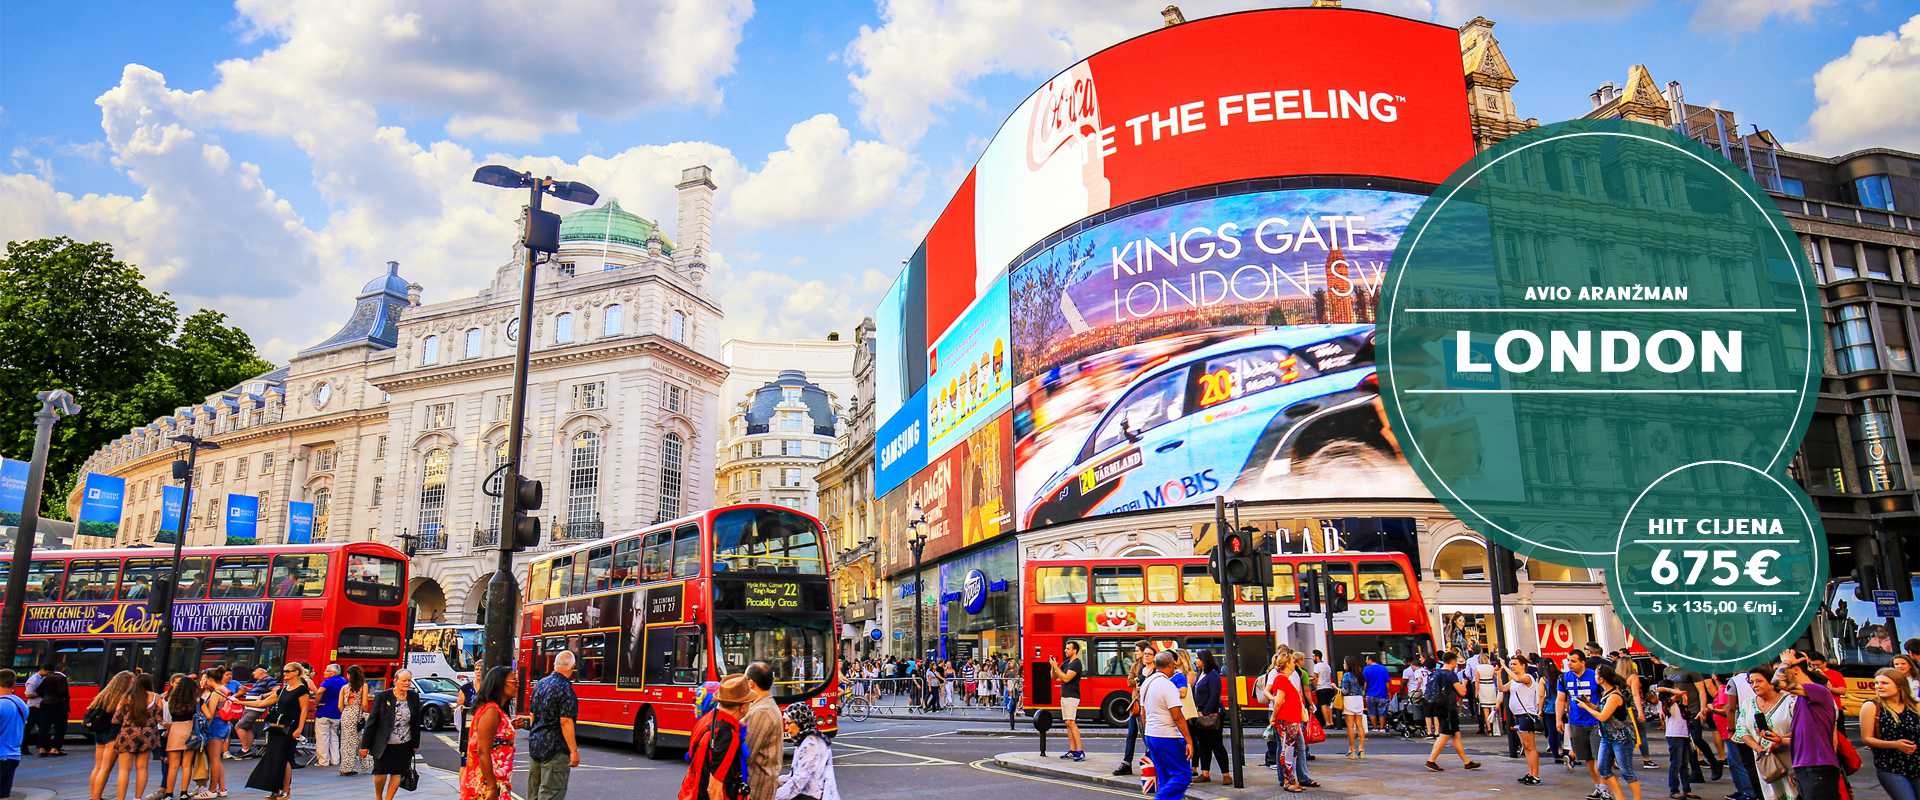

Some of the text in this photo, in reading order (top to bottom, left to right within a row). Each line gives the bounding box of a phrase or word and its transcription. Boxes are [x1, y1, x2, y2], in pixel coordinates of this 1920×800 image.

[1125, 101, 1207, 147] THE
[1112, 215, 1368, 281] KINGS GATE
[1114, 261, 1311, 323] LONDON
[1200, 370, 1231, 406] 20
[881, 419, 920, 472] SAMSUNG
[1143, 469, 1220, 510] MOBIS
[746, 598, 798, 609] Piccadilly Circus
[784, 583, 797, 596] 22
[559, 612, 583, 626] BOURNE
[653, 602, 675, 613] JULY 27
[188, 617, 206, 631] THE
[211, 616, 239, 630] WEST
[1538, 621, 1574, 649] 70
[411, 655, 437, 665] MAJESTIC
